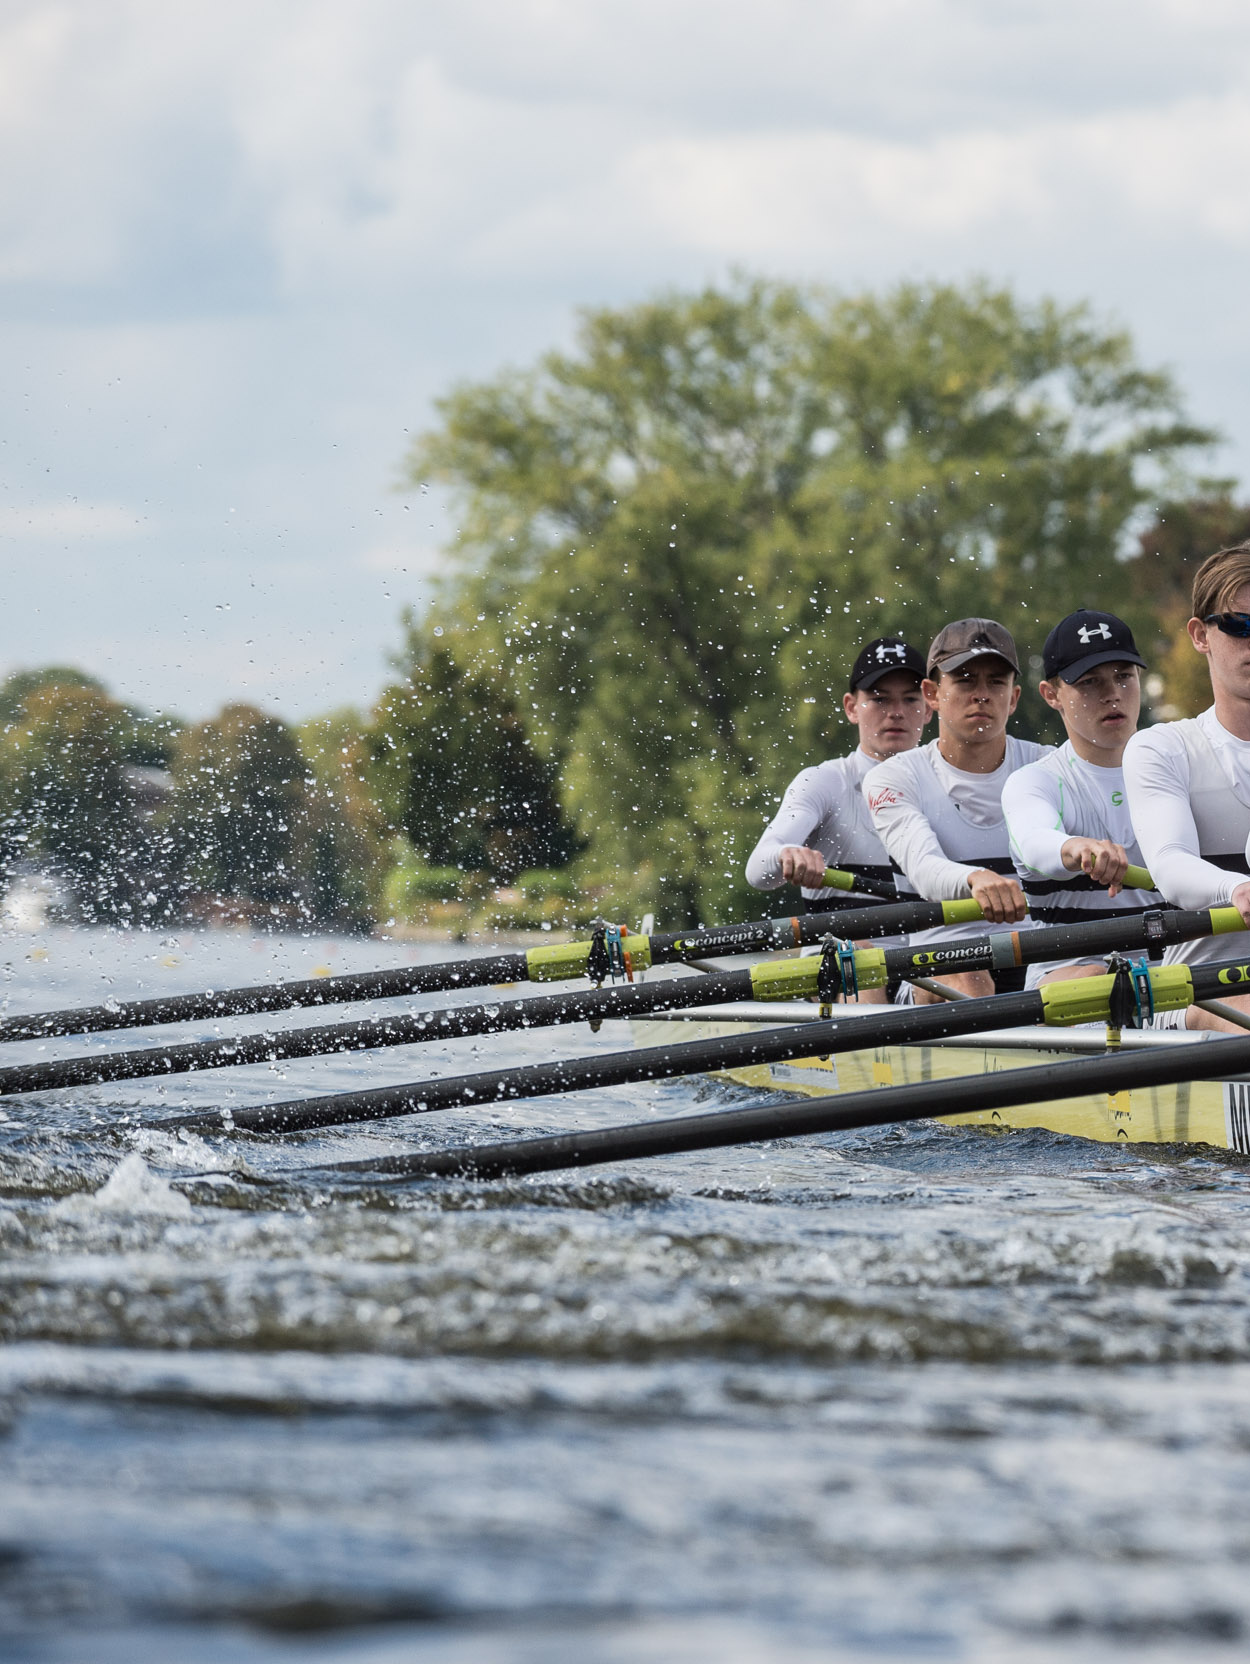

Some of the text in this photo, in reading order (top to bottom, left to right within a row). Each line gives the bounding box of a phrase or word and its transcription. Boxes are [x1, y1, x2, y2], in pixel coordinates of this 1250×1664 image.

[695, 931, 753, 947] concept
[755, 929, 764, 940] 2
[935, 944, 993, 961] concep
